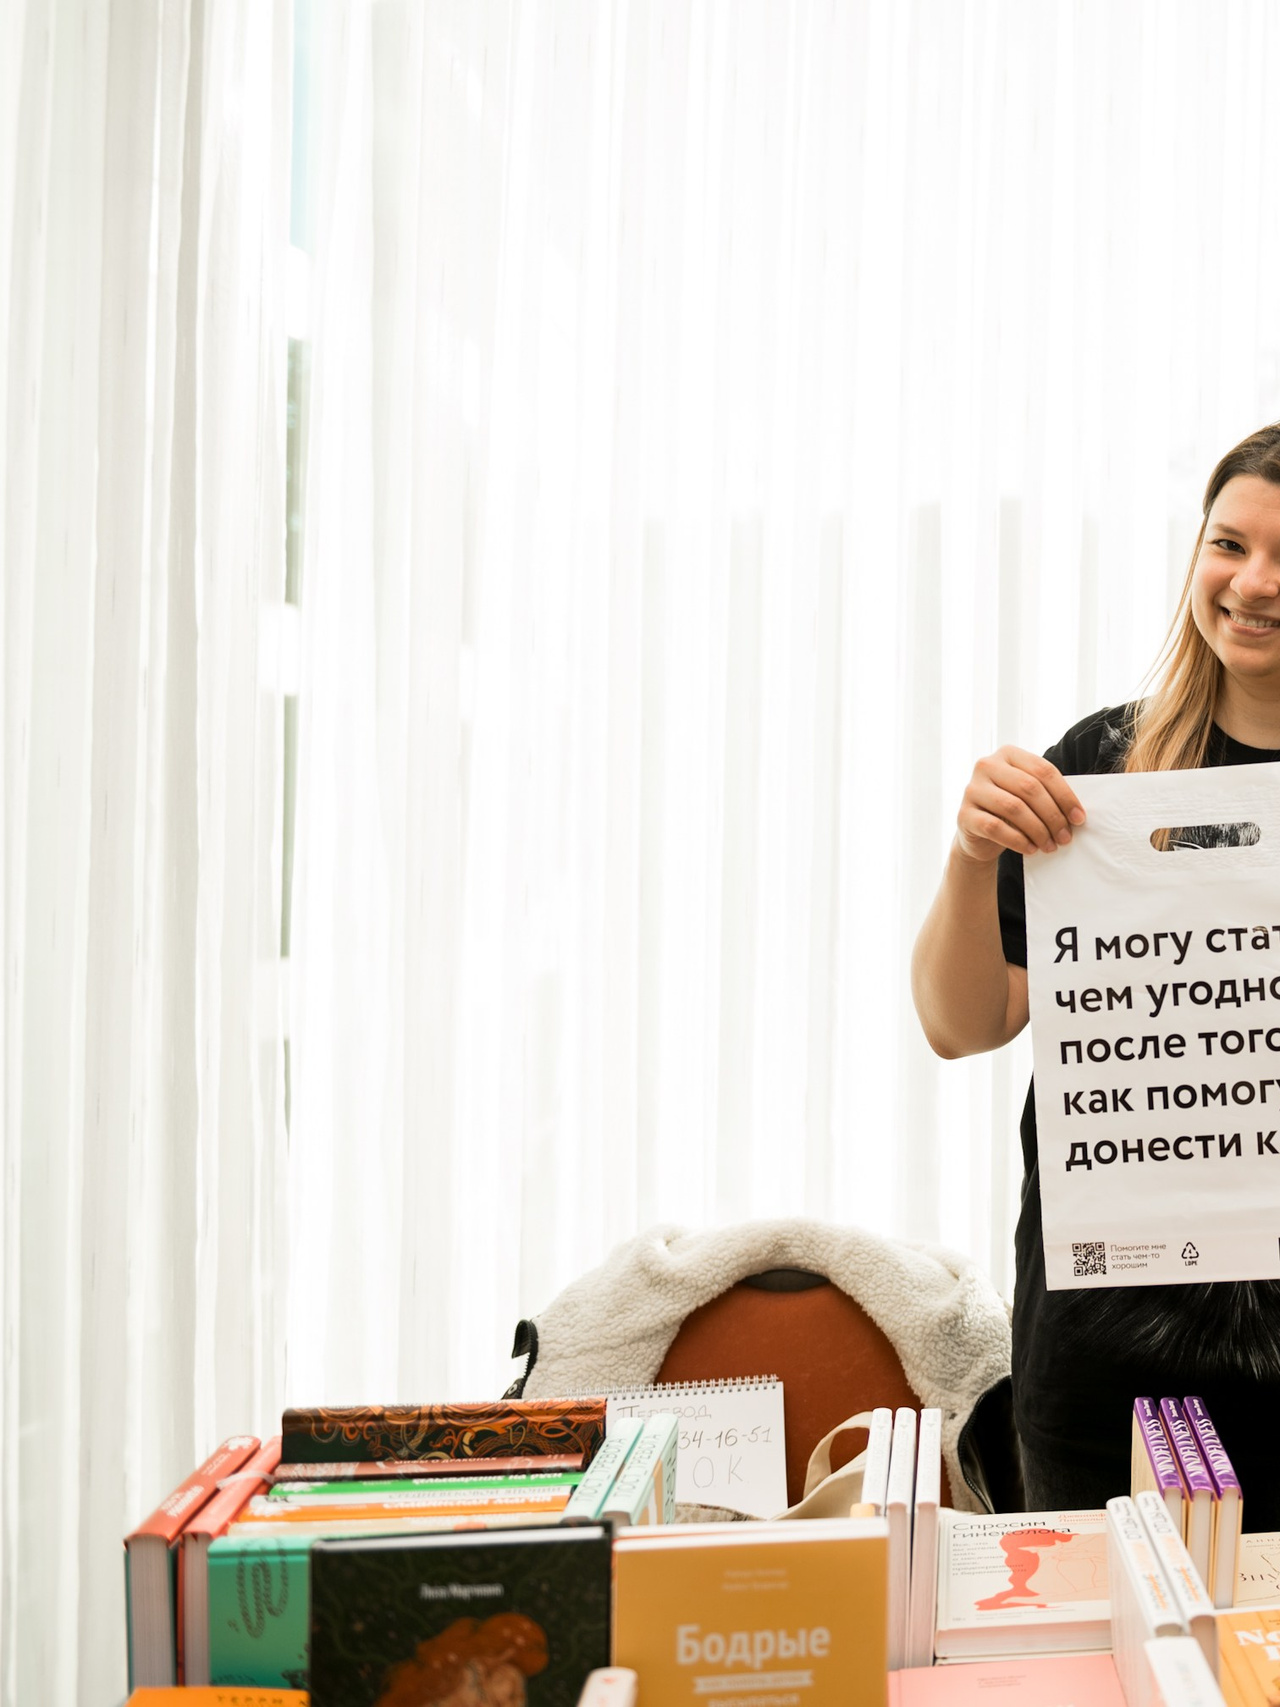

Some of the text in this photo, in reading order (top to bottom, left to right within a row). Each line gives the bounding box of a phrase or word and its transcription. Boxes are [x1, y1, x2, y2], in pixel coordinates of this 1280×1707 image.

[1054, 926, 1079, 963] Я
[1095, 930, 1193, 965] могу
[1055, 980, 1133, 1014] чем
[1060, 1028, 1186, 1064] после
[1063, 1086, 1134, 1116] как
[1065, 1130, 1242, 1171] донести
[1110, 1244, 1149, 1252] Помогите
[1111, 1253, 1131, 1261] стать
[1111, 1262, 1148, 1270] хорошим
[953, 1521, 1046, 1531] Спросим
[953, 1528, 1071, 1539] гинеколога
[676, 1623, 831, 1670] Бодрые
